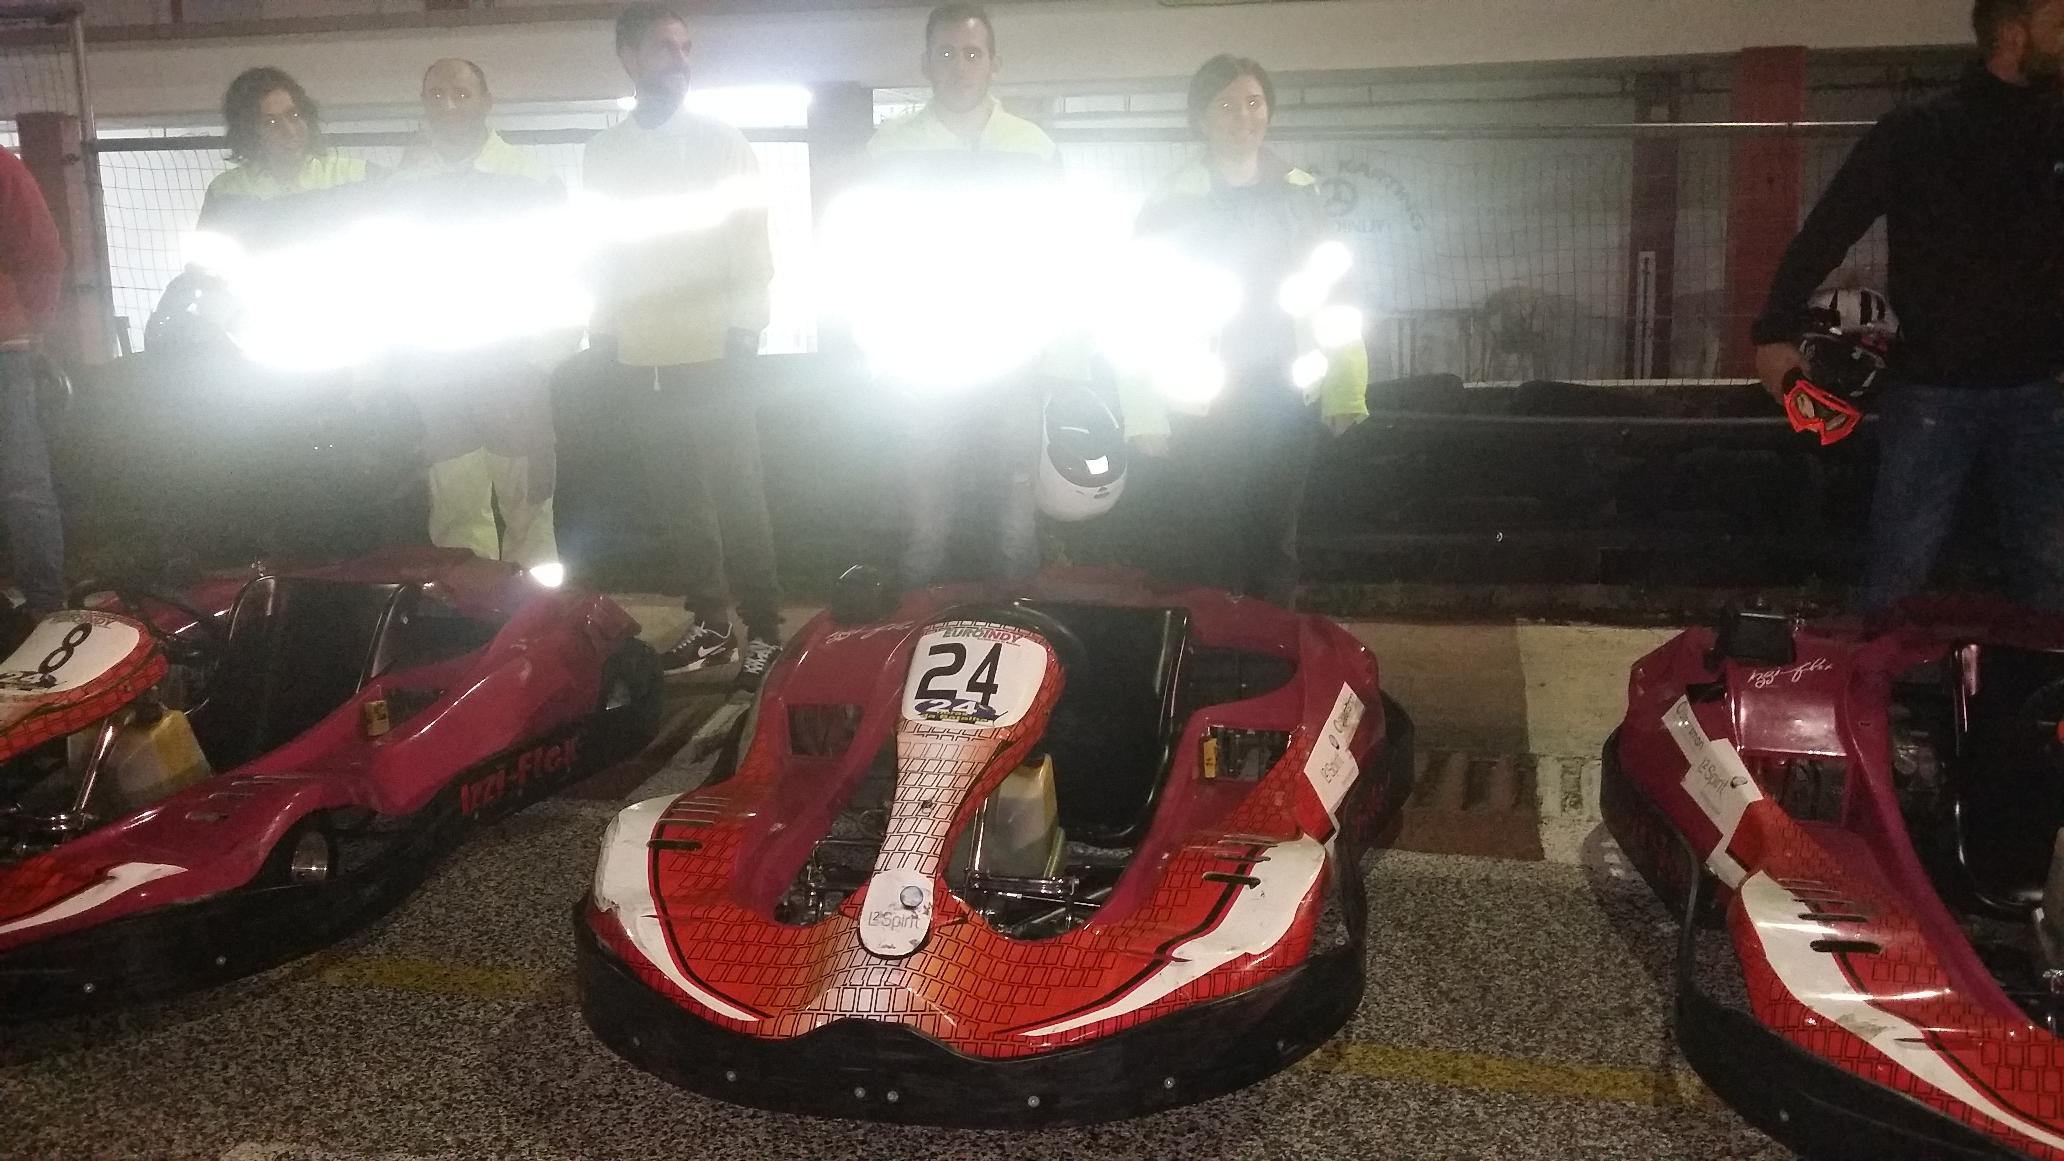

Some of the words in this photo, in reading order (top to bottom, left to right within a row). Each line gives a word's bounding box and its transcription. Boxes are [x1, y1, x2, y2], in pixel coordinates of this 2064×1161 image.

[38, 622, 93, 674] 8
[943, 626, 1021, 643] EUROINDY
[914, 642, 1003, 706] 24
[926, 698, 978, 715] 24
